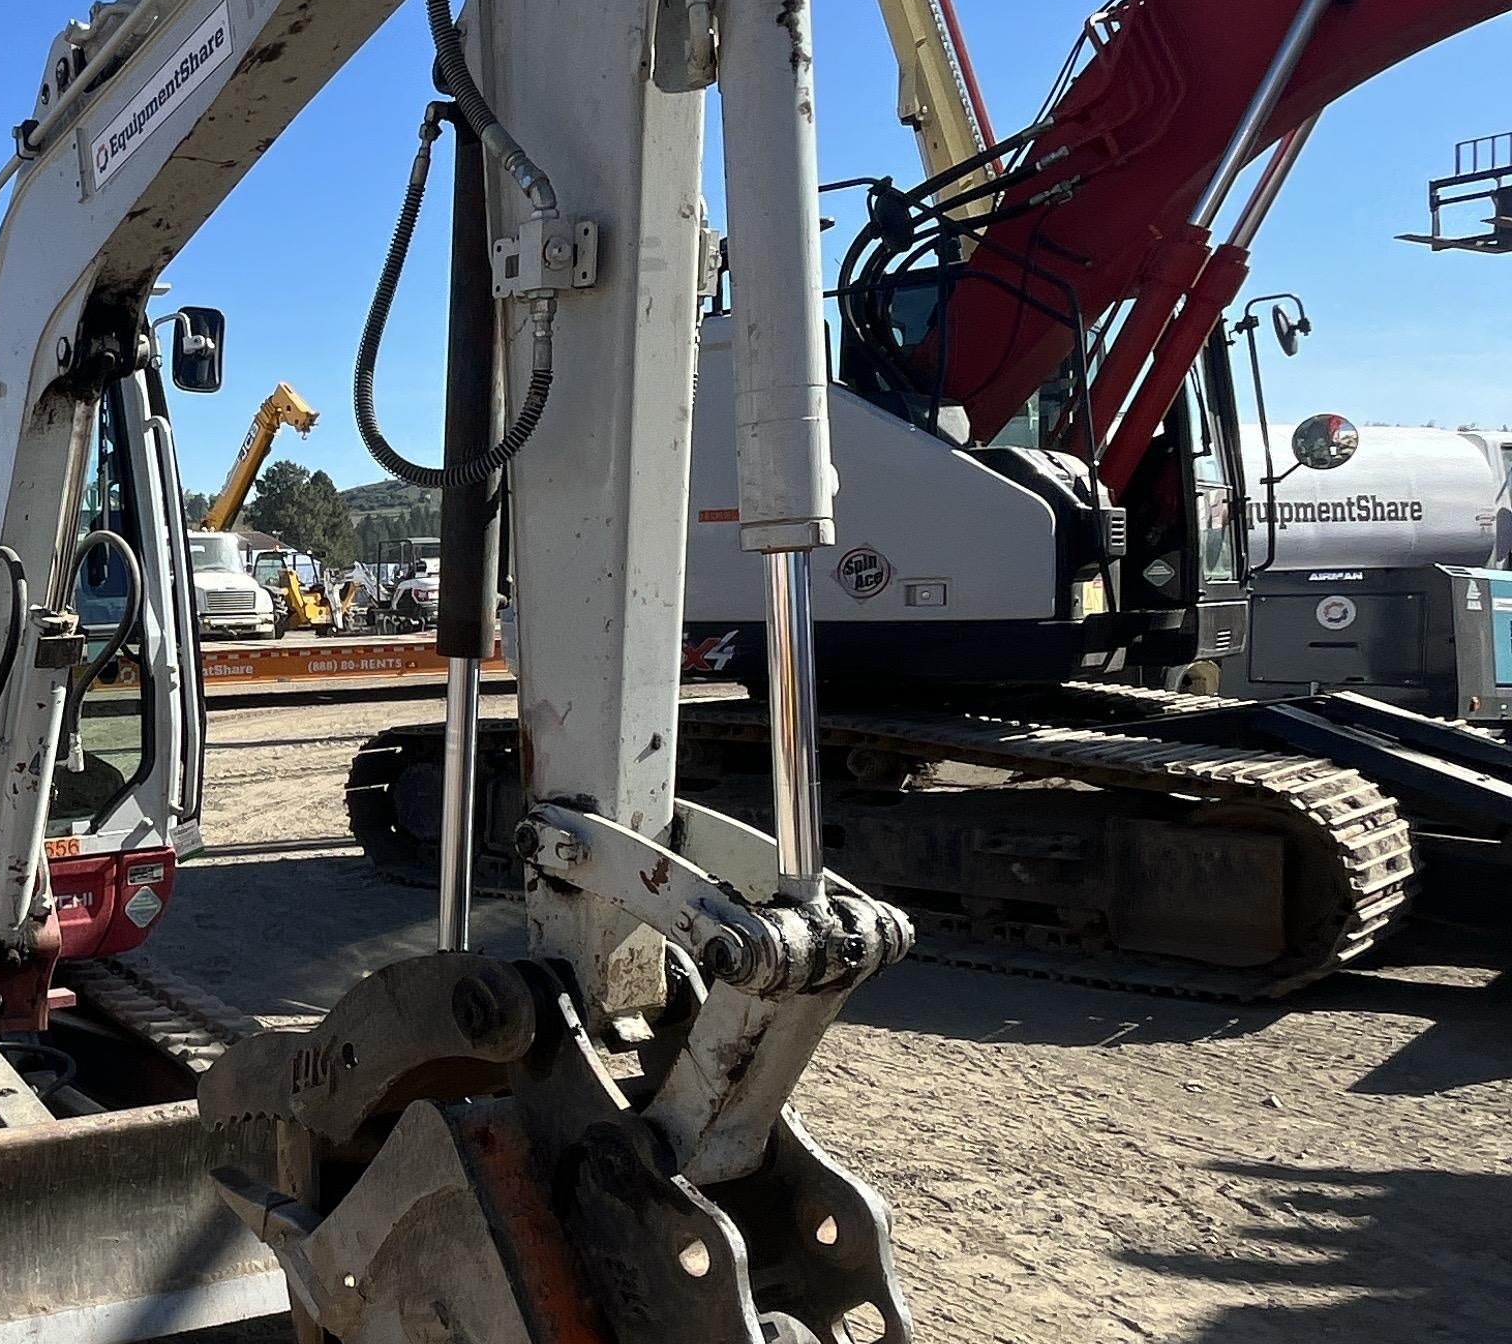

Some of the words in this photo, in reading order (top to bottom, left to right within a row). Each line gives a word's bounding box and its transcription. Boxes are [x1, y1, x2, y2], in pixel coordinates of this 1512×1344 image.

[108, 26, 224, 160] EquipmentShare
[843, 555, 878, 576] Spin
[854, 571, 884, 591] Ace
